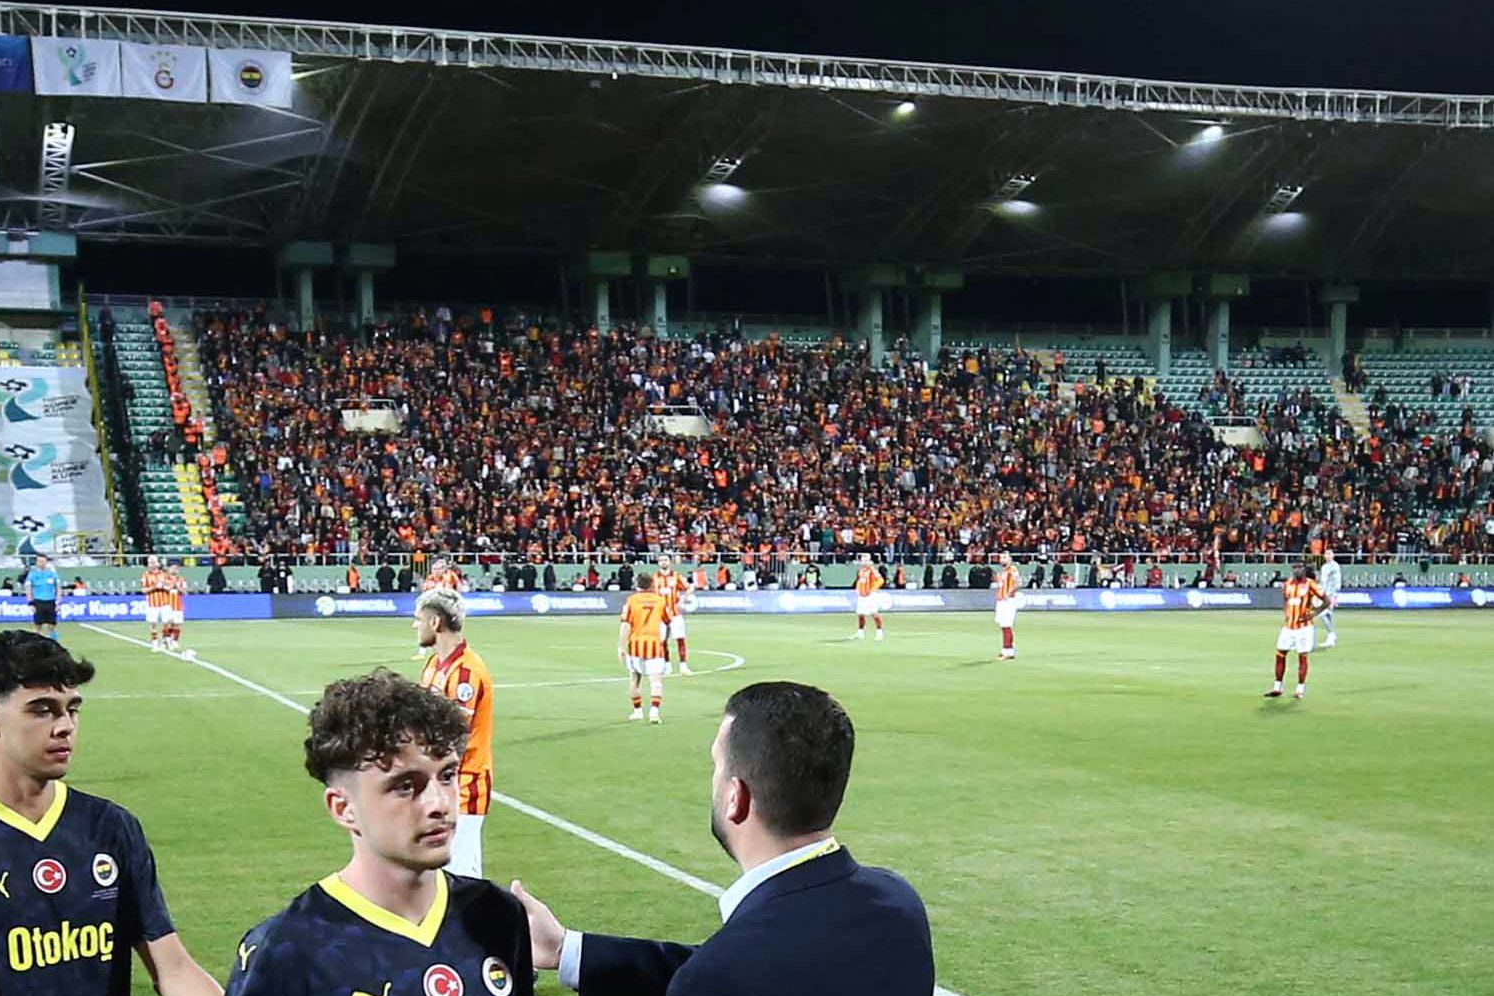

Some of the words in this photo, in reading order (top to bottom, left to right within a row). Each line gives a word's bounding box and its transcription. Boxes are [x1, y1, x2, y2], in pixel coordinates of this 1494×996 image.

[88, 600, 128, 618] Kupa
[641, 605, 655, 626] 7
[7, 920, 114, 972] Otokoç
